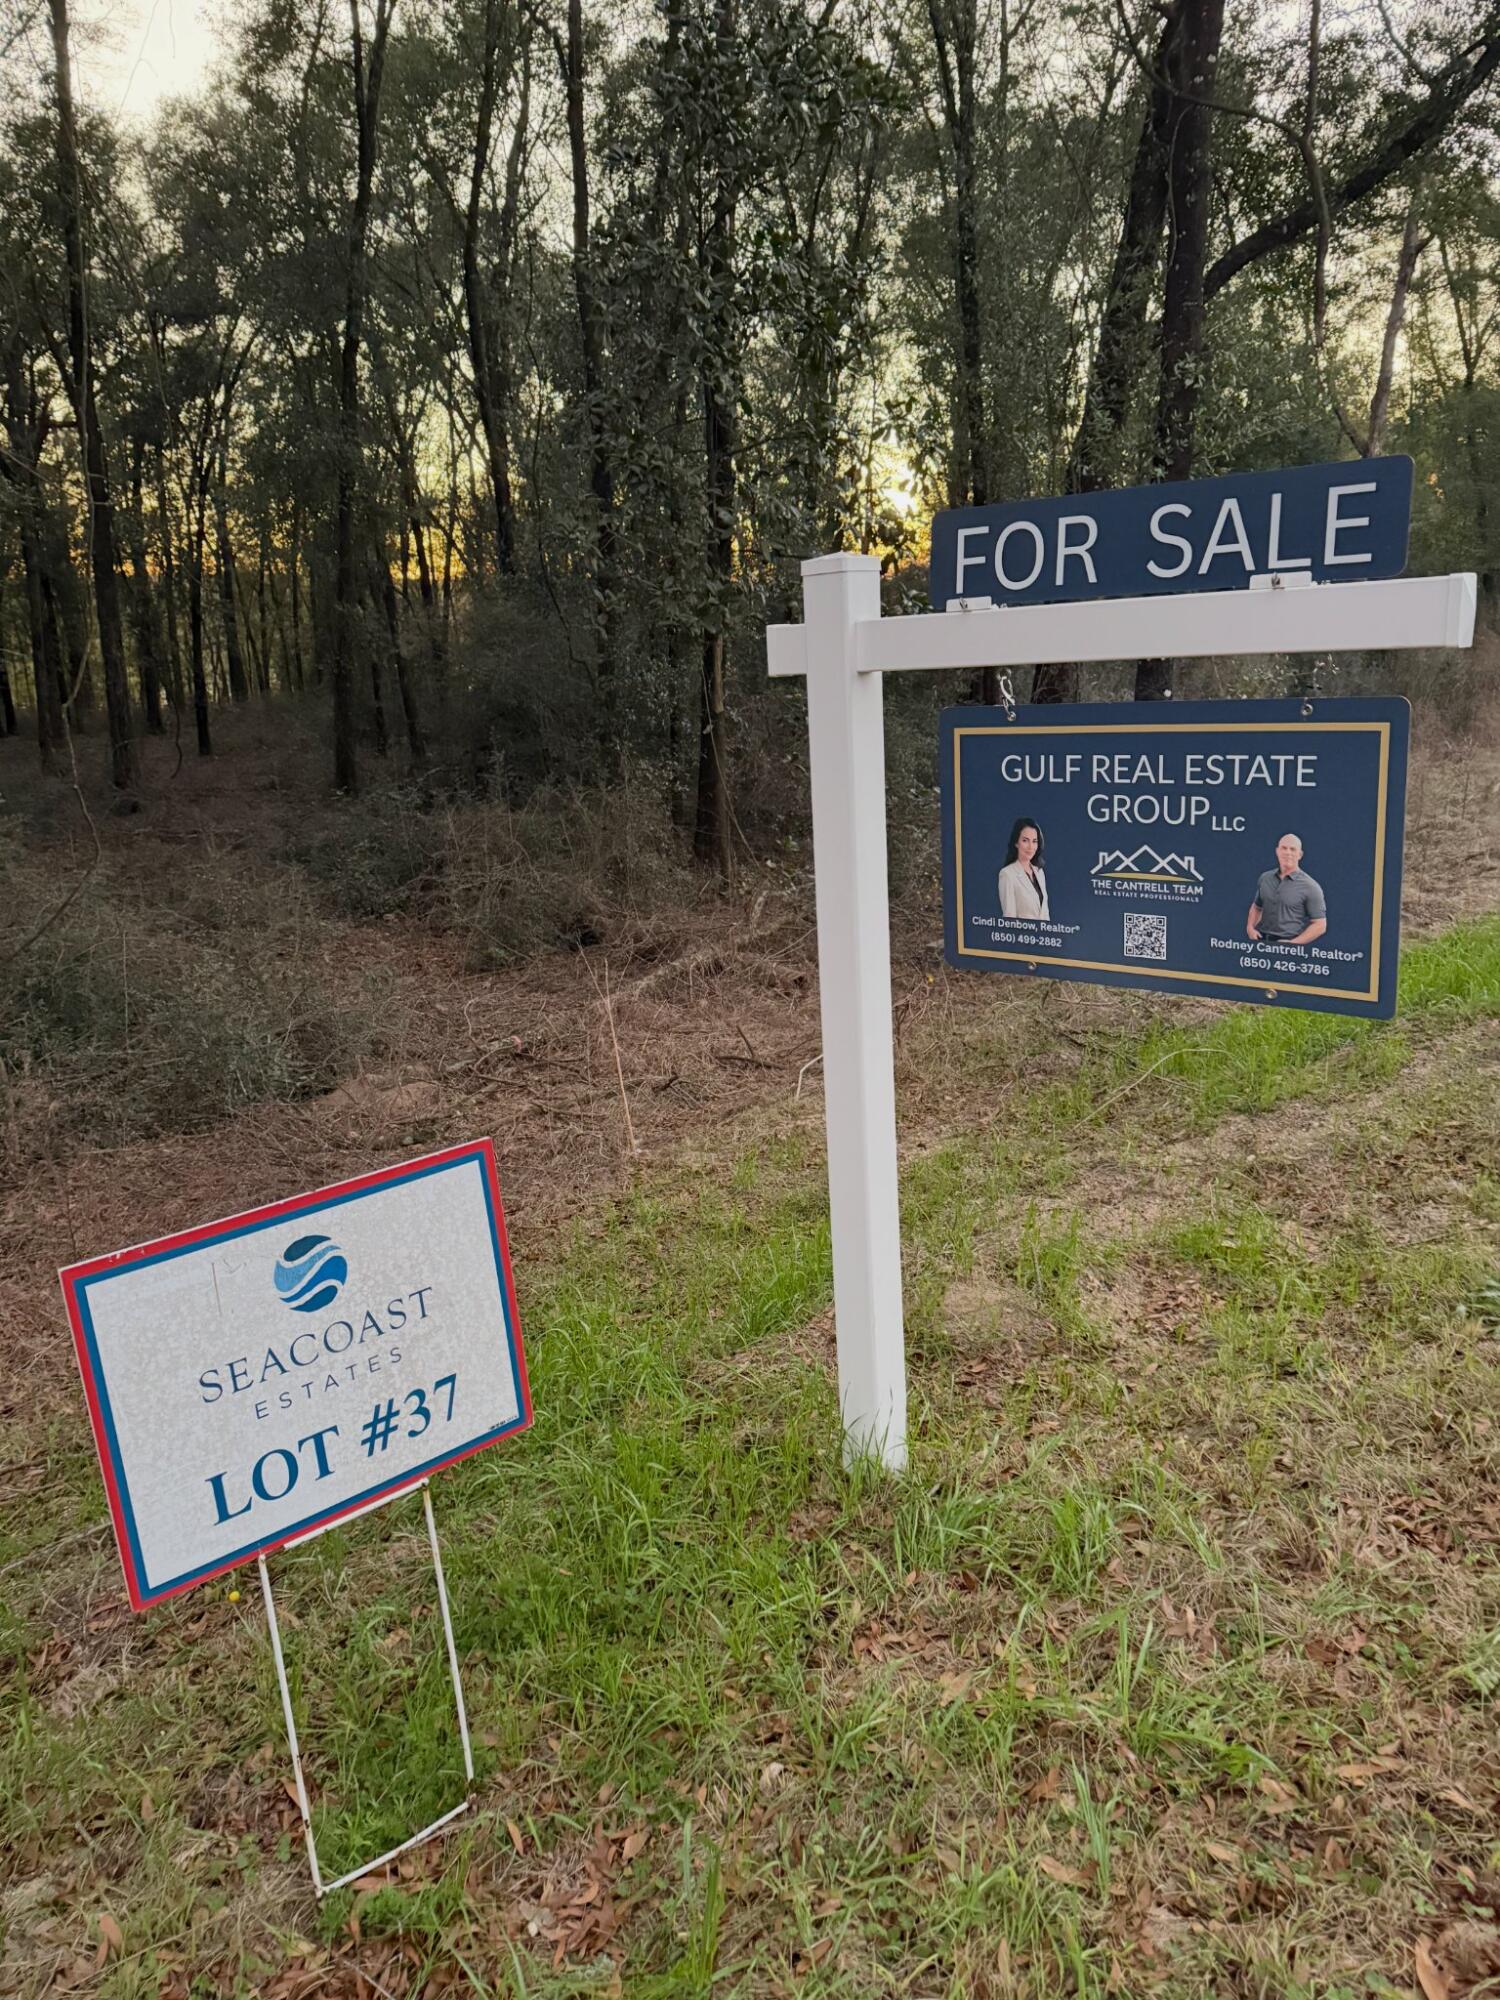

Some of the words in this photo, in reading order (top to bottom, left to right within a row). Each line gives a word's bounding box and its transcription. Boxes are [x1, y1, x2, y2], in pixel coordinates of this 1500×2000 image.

[956, 515, 1098, 594] FOR
[1146, 482, 1377, 579] SALE
[1001, 754, 1083, 784] GULF
[1092, 754, 1175, 785] REAL
[1185, 755, 1318, 787] ESTATE
[1087, 794, 1210, 826] GROUP
[1212, 816, 1246, 833] LLC
[1091, 879, 1112, 889] THE
[1115, 881, 1170, 893] CANTRELL
[1173, 884, 1204, 896] TEAM
[1094, 889, 1111, 897] REAL
[1113, 890, 1138, 898] ESTATE
[1140, 892, 1200, 903] PROFESSIONALS
[972, 916, 996, 926] Cindi
[997, 919, 1039, 932] Denbow,
[991, 932, 1016, 943] (850)
[1017, 935, 1063, 947] 499-2882
[1210, 937, 1254, 953] Rodney
[1256, 942, 1309, 959] Cantrell,
[1239, 956, 1271, 970] (850)
[1273, 960, 1330, 976] 426-3786
[198, 1286, 433, 1404] SEACOAST
[254, 1347, 403, 1420] ESTATES
[205, 1425, 340, 1527] LOT
[361, 1373, 458, 1458] #37
